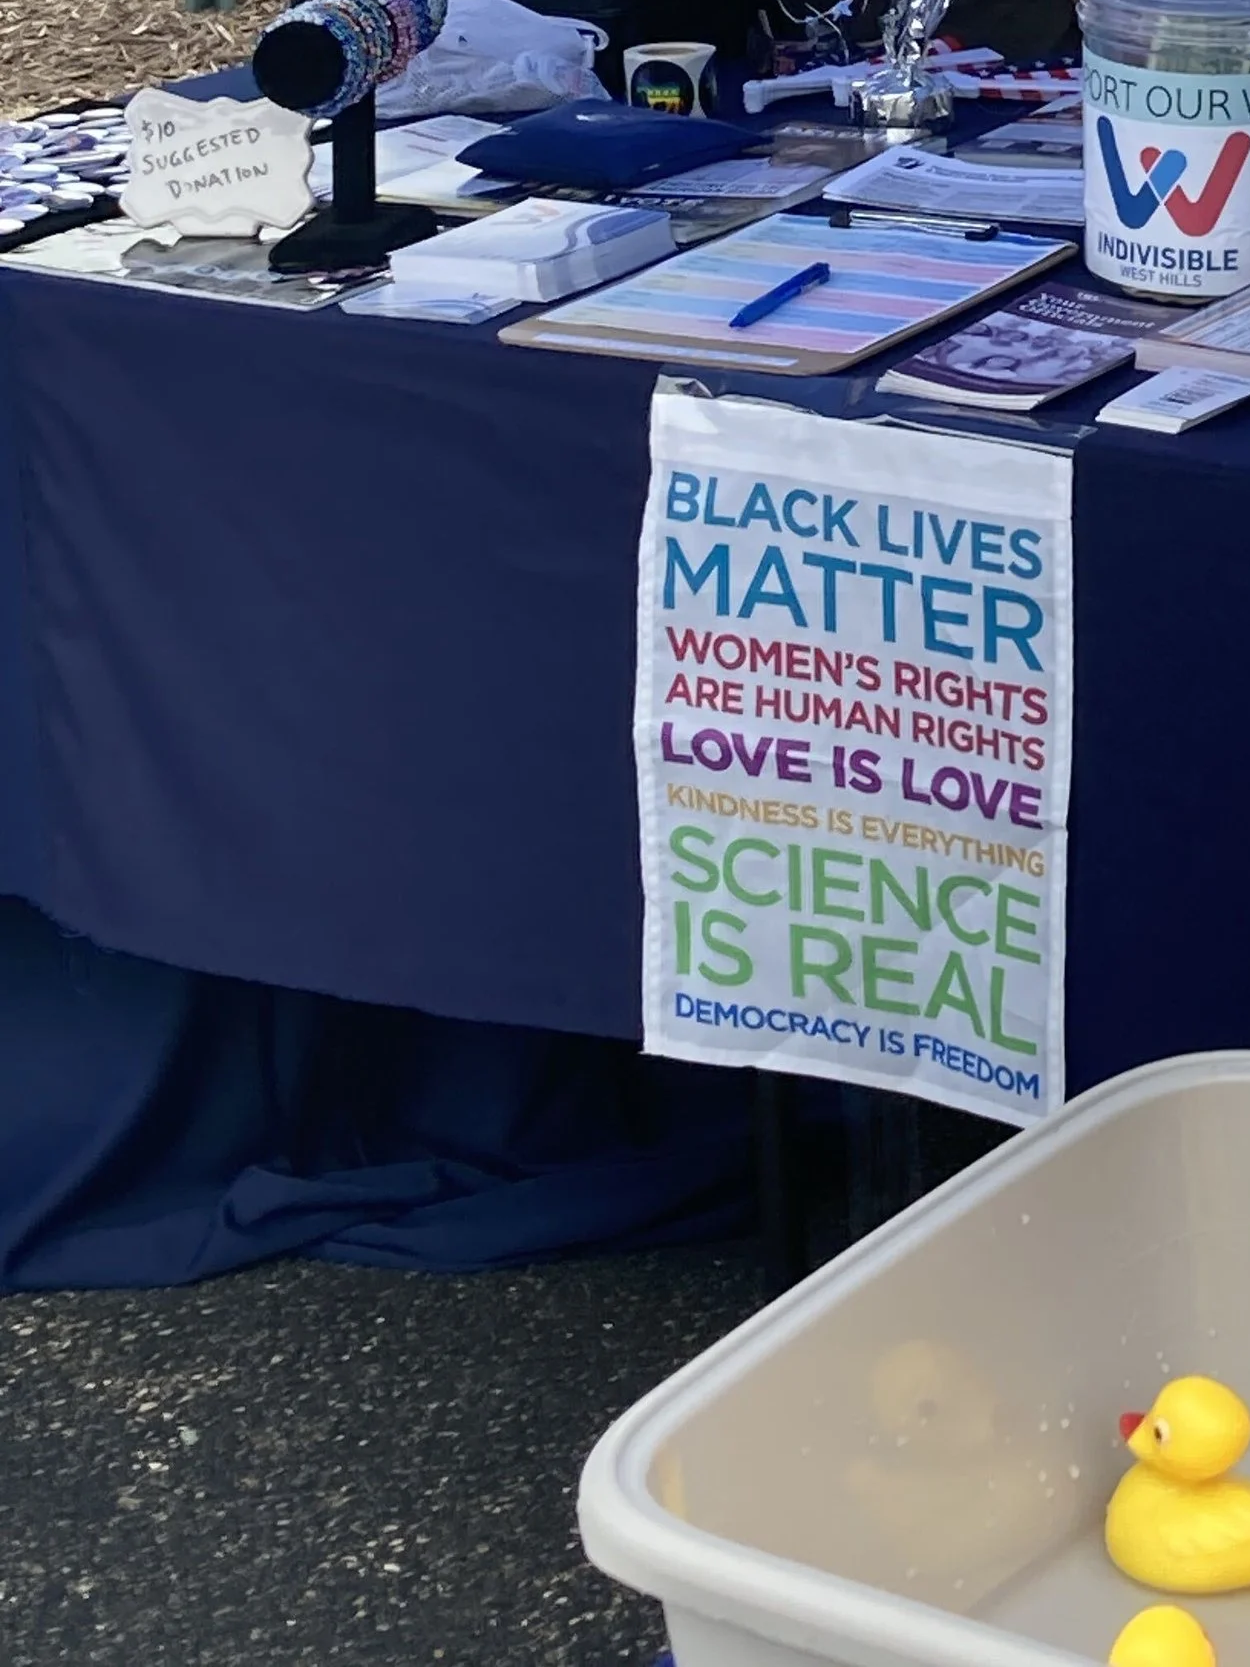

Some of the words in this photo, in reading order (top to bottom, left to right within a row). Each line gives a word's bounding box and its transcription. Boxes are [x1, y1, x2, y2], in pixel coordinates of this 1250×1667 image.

[141, 119, 175, 143] $10
[142, 127, 261, 175] SUGGESTED
[1146, 84, 1232, 121] OUR
[1097, 230, 1239, 272] INDIVISIBLE
[1120, 265, 1154, 283] WEST
[1159, 267, 1203, 287] HILLS
[666, 471, 859, 548] BLACK
[878, 504, 1043, 580] LIVES
[662, 536, 1044, 672] MATTER
[665, 625, 881, 692] WOMEN'S
[894, 660, 1049, 725] RIGHTS
[665, 672, 744, 715] ARE
[755, 689, 901, 738] HUMAN
[912, 710, 1046, 771] RIGHTS
[660, 721, 812, 783] LOVE
[833, 745, 882, 794] IS
[902, 758, 1043, 830] LOVE
[666, 782, 819, 829] KINDNESS
[827, 807, 853, 834] IS
[861, 815, 1046, 877] EVERYTHING
[668, 825, 1041, 964] SCIENCE
[673, 900, 753, 987] IS
[789, 923, 1037, 1056] REAL
[676, 993, 871, 1048] DEMOCRACY
[879, 1028, 905, 1055] IS
[914, 1033, 1039, 1099] FREEDOM
